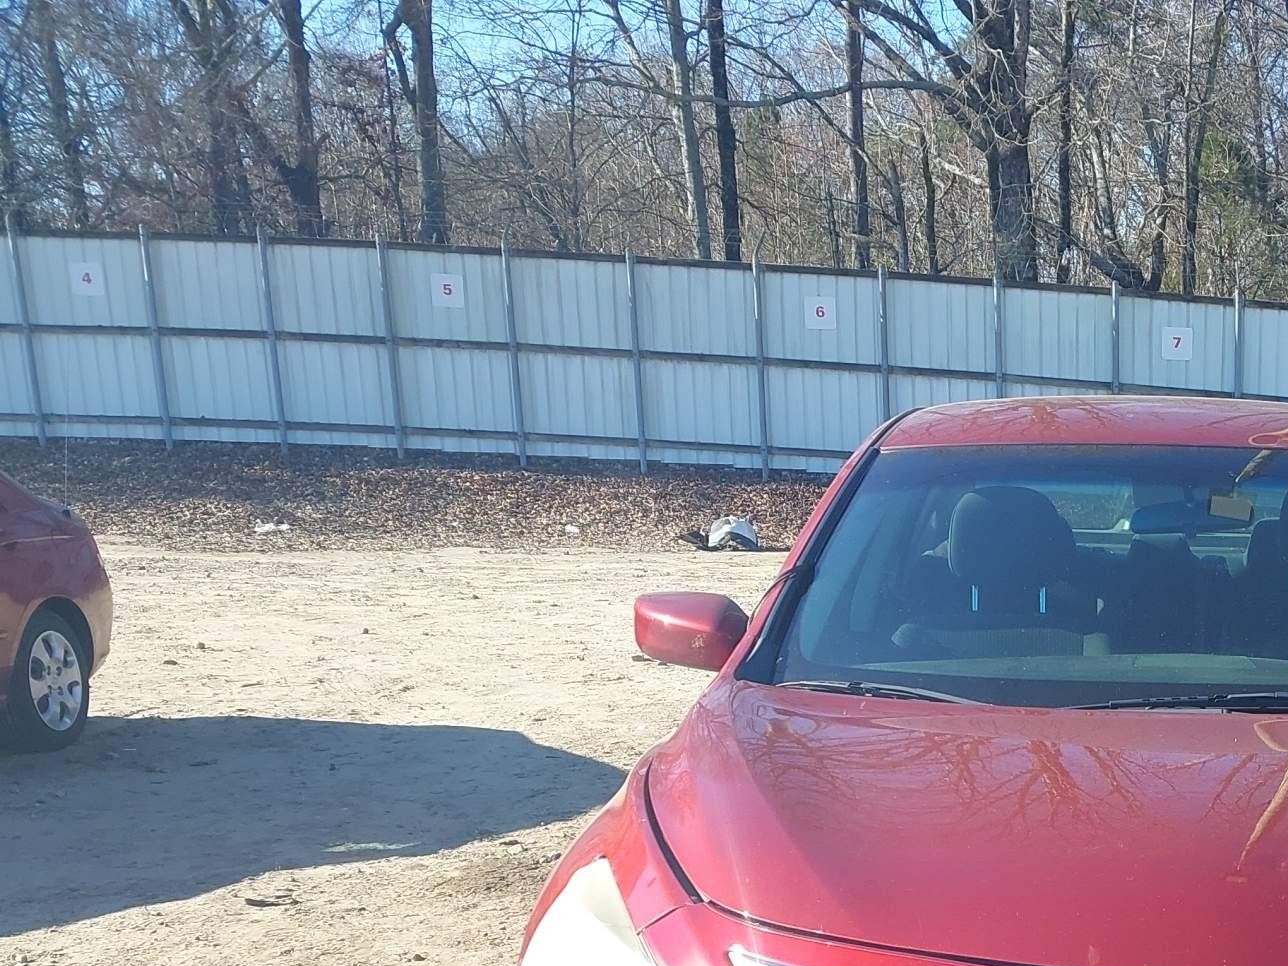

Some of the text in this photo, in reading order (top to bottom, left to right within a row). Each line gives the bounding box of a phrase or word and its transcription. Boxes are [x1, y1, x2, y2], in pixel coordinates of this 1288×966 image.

[81, 272, 92, 284] 4
[442, 283, 453, 296] 5
[815, 305, 825, 318] 6
[1172, 336, 1182, 349] 7
